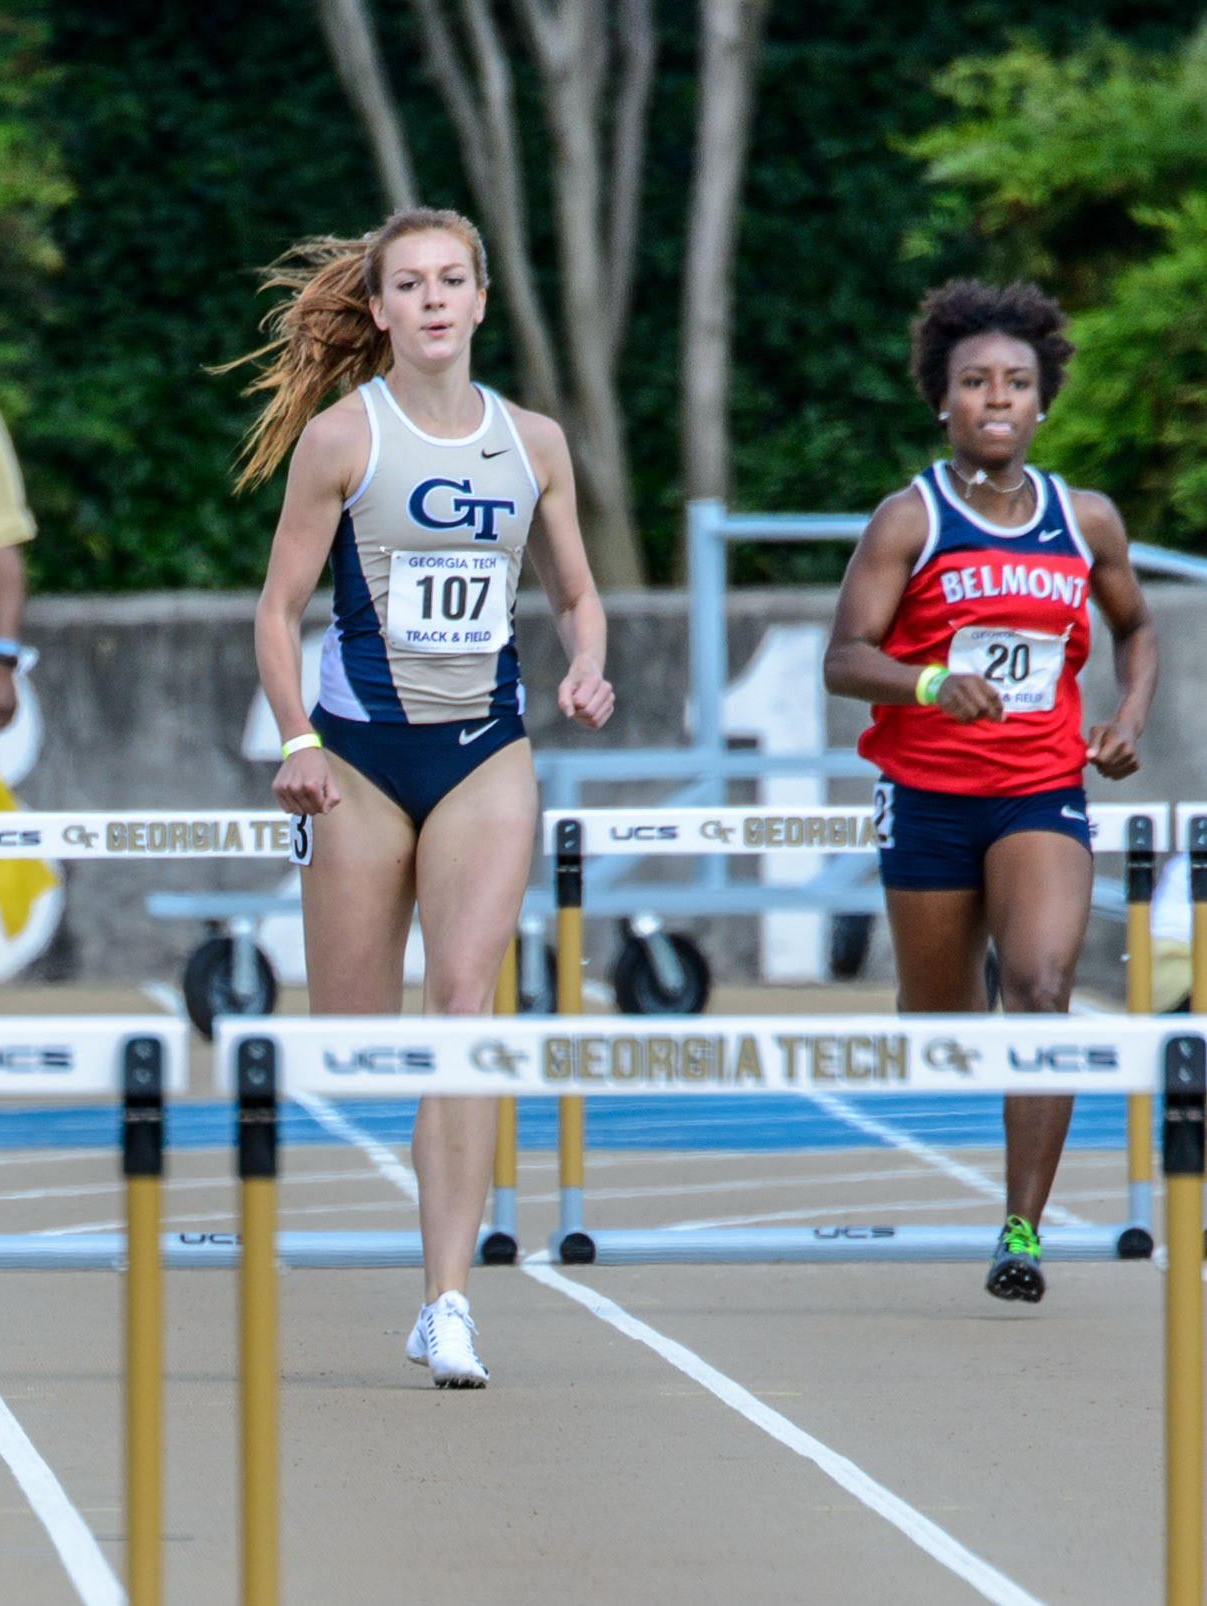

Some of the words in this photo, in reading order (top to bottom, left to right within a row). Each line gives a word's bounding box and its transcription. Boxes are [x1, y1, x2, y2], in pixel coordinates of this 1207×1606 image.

[407, 477, 515, 541] GT
[408, 557, 468, 569] GEORGIA
[473, 558, 496, 569] TECH
[416, 575, 491, 621] 107
[940, 565, 1086, 609] BELMONT
[406, 630, 447, 642] TRACK
[451, 632, 460, 642] &
[464, 631, 491, 643] FIELD
[984, 643, 1031, 681] 20
[1014, 692, 1043, 703] FIELD
[107, 821, 244, 851] GEORGIA
[250, 821, 290, 850] TE
[610, 825, 678, 840] UCS
[743, 816, 879, 848] GEORGIA
[323, 1046, 436, 1075] UCS
[542, 1034, 765, 1085] GEORGIA
[774, 1034, 910, 1081] TECH
[1007, 1044, 1119, 1073] UCS
[180, 1232, 242, 1245] UC
[814, 1227, 895, 1238] UCS
